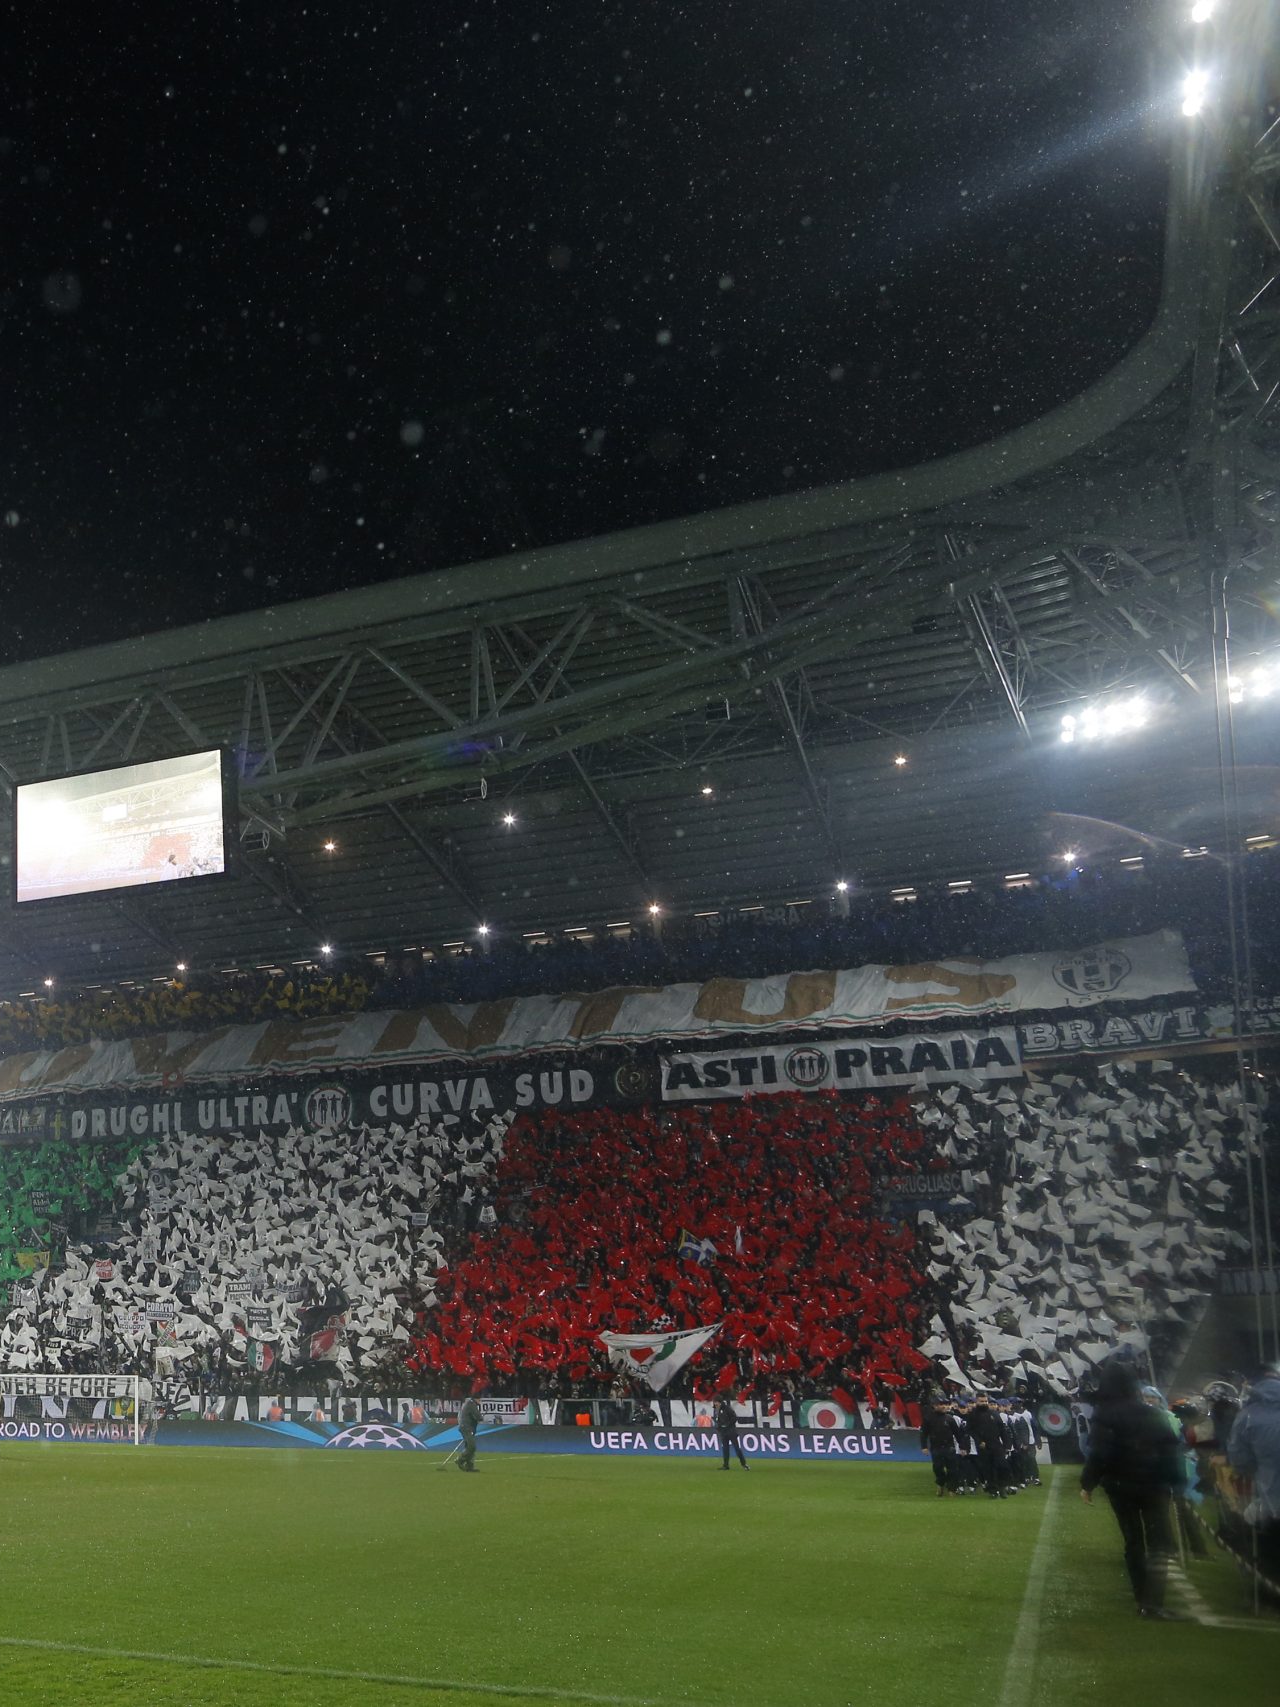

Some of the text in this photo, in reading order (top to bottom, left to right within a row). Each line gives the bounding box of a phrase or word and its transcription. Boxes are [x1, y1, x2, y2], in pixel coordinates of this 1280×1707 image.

[1023, 1006, 1200, 1053] BRAVI
[666, 1037, 1017, 1091] ASTI PRAIA
[71, 1102, 183, 1139] DRUGHI
[370, 1077, 493, 1118] CURVA
[516, 1069, 595, 1104] SUD
[46, 1378, 116, 1398] BEFORE
[44, 1422, 65, 1439] TO
[589, 1431, 895, 1456] UEFA CHAMIONS LEAGUE
